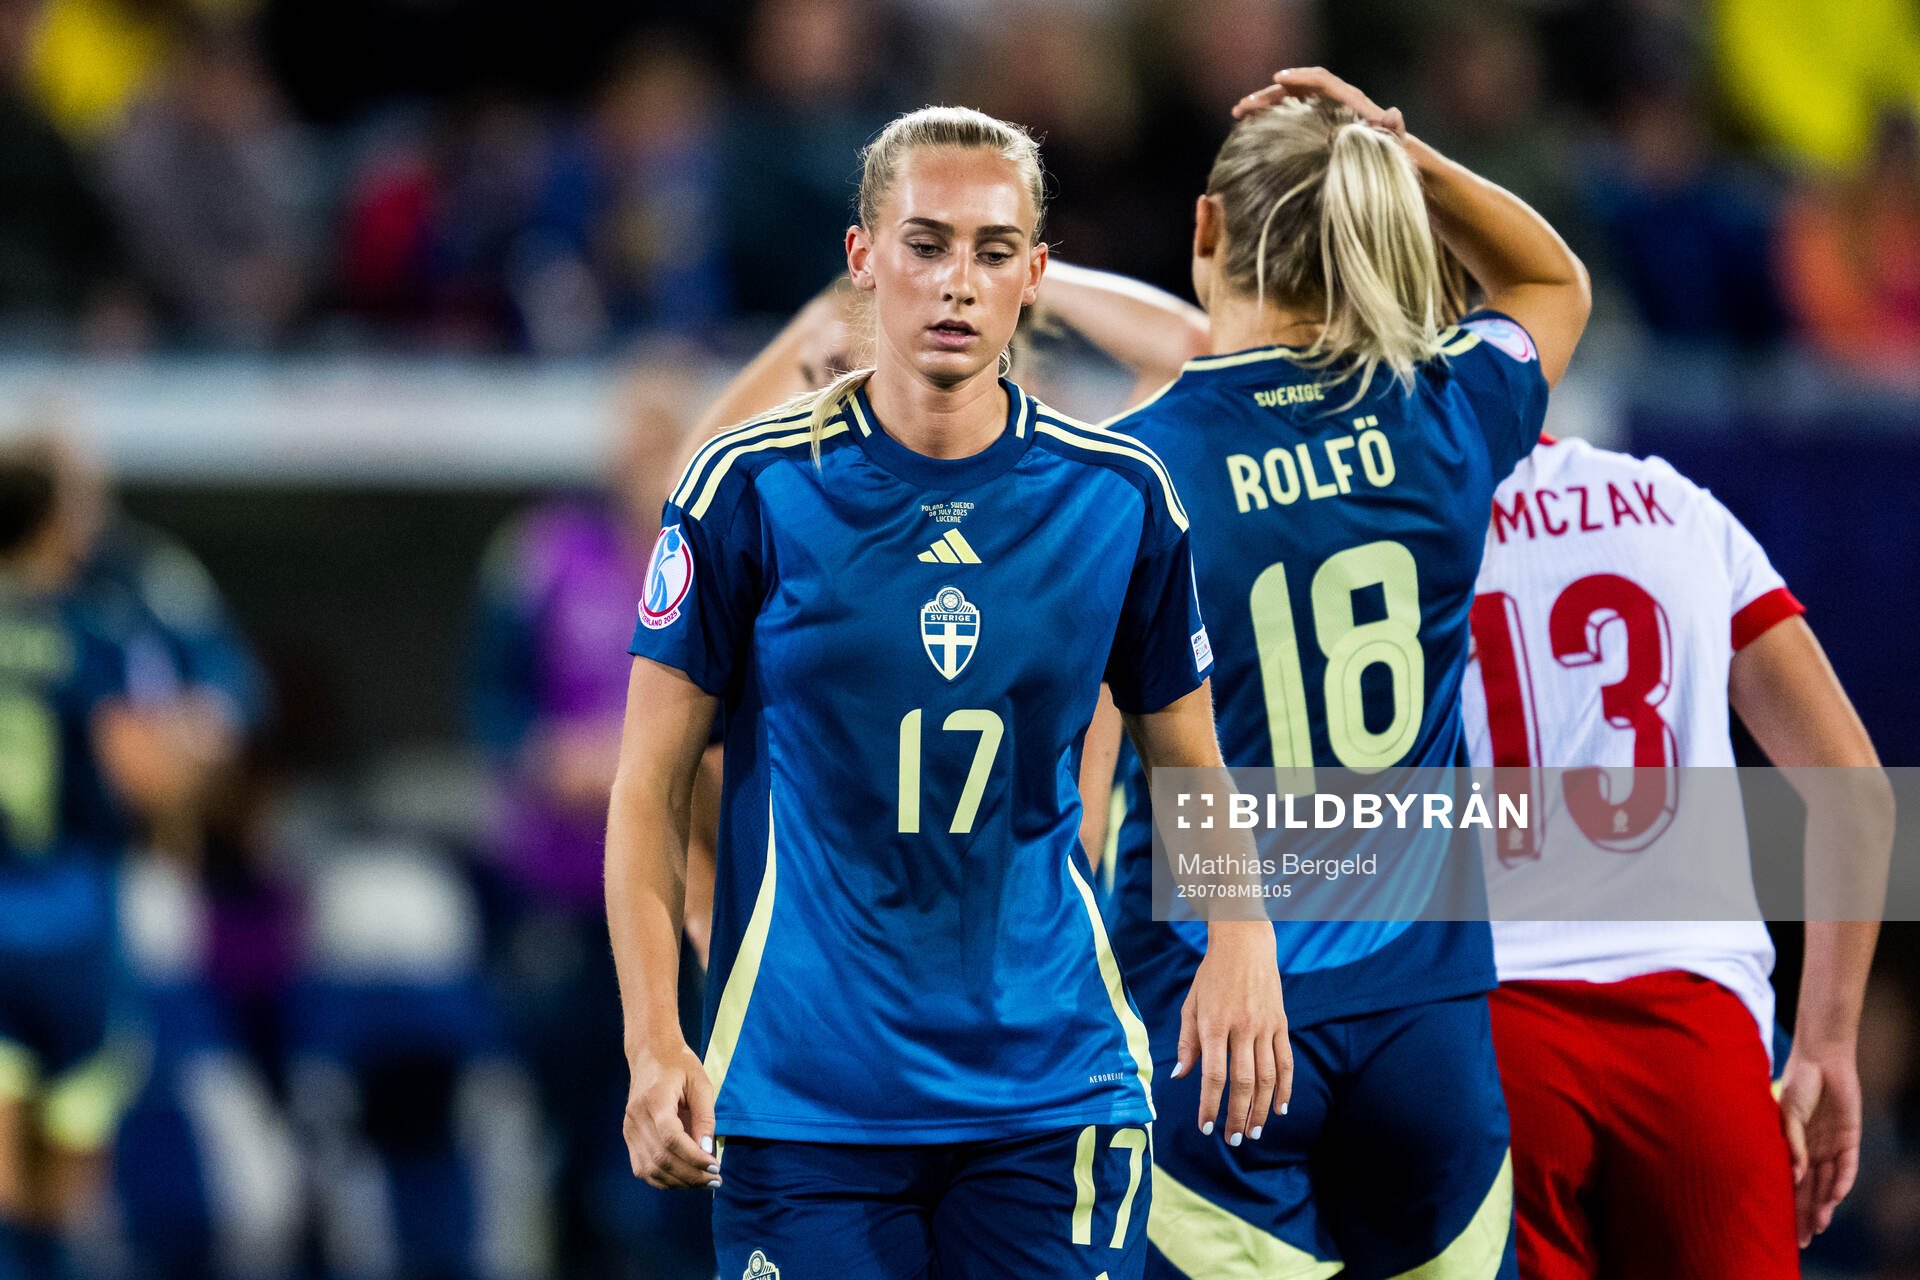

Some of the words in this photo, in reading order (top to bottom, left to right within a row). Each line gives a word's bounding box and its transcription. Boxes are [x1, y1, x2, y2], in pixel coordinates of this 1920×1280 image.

[1254, 383, 1325, 407] SVERIGE
[1226, 415, 1396, 514] ROLFÖ
[921, 504, 944, 512] POLAND
[950, 501, 975, 509] SWEDEN
[952, 509, 968, 517] 2025
[663, 610, 678, 625] 2025
[930, 614, 971, 622] SVERIGE
[1249, 540, 1425, 801] 18
[1470, 573, 1680, 869] 13
[898, 708, 1005, 833] 17
[1071, 1124, 1148, 1249] 17
